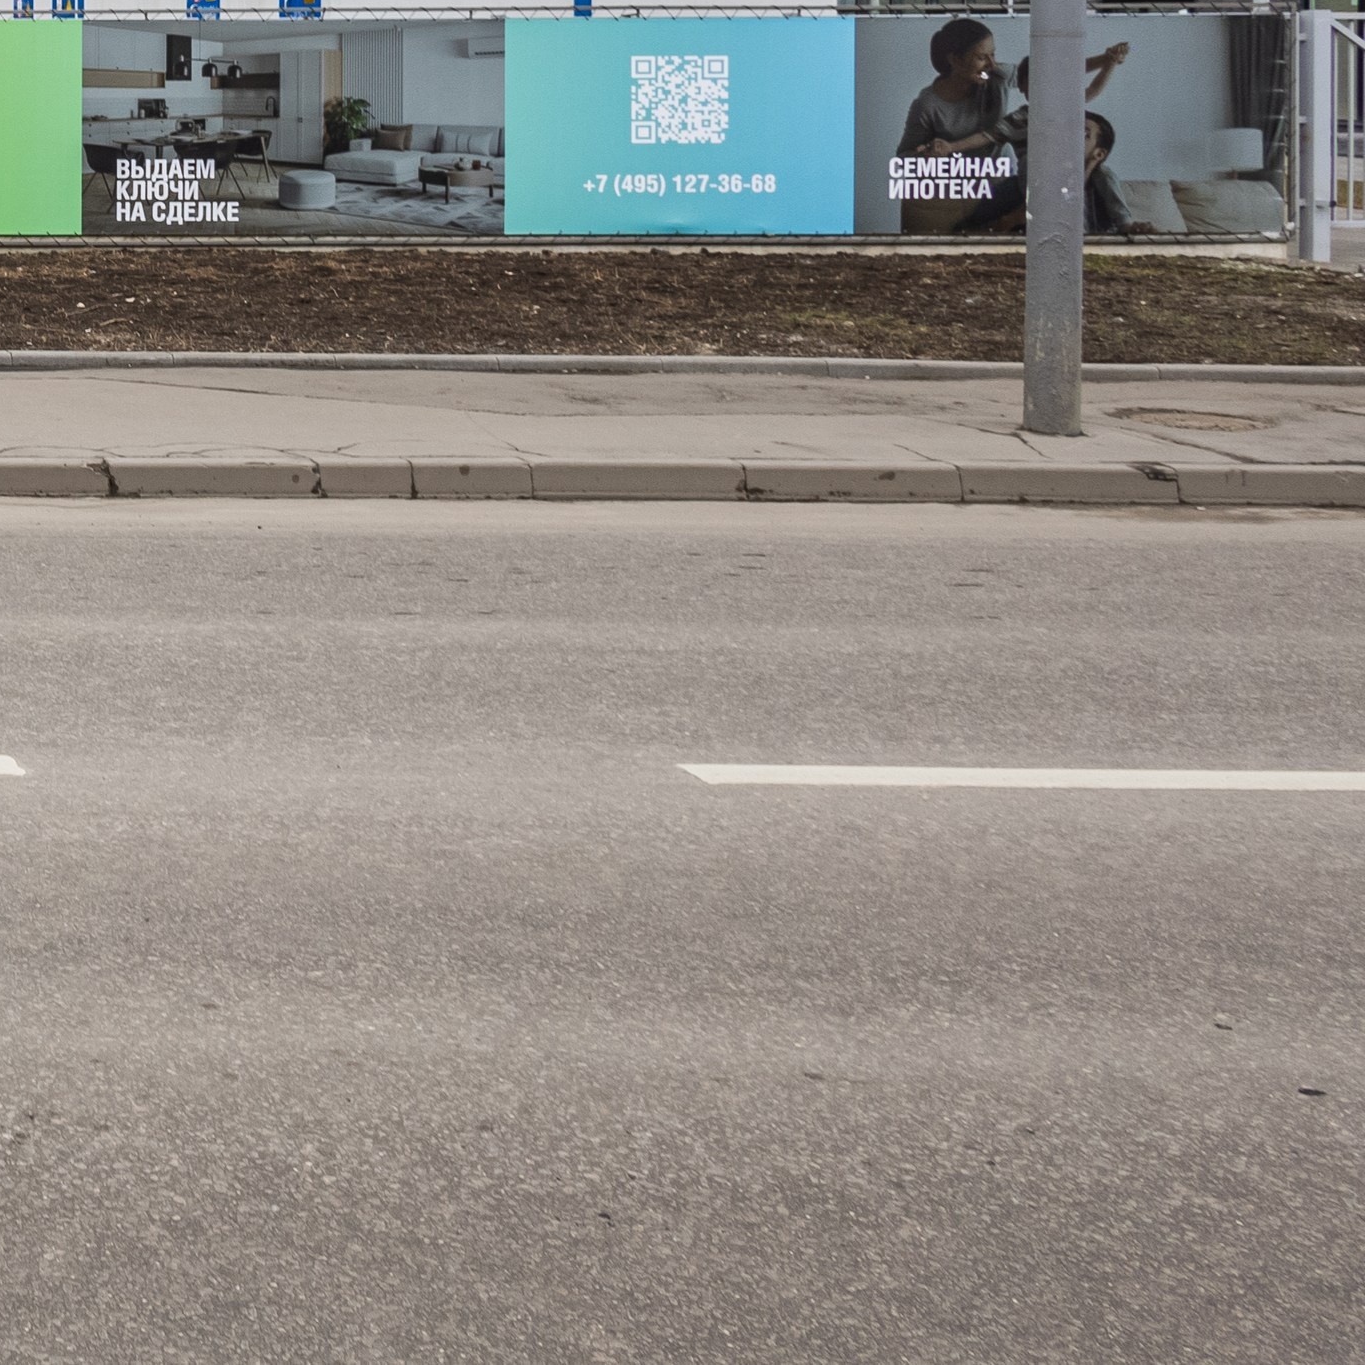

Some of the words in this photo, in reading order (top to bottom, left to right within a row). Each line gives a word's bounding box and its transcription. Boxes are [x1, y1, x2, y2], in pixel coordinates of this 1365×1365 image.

[116, 158, 215, 182] ВЫДАЕМ
[888, 152, 1011, 178] СЕМЕЙНАЯ
[116, 180, 199, 201] КЛЮЧИ
[583, 174, 608, 193] +7
[613, 174, 666, 197] (495)
[672, 174, 776, 194] 127-36-68
[888, 178, 993, 200] ИПОТЕКА
[116, 201, 146, 222] НА
[152, 201, 240, 225] СДЕЛКЕ
